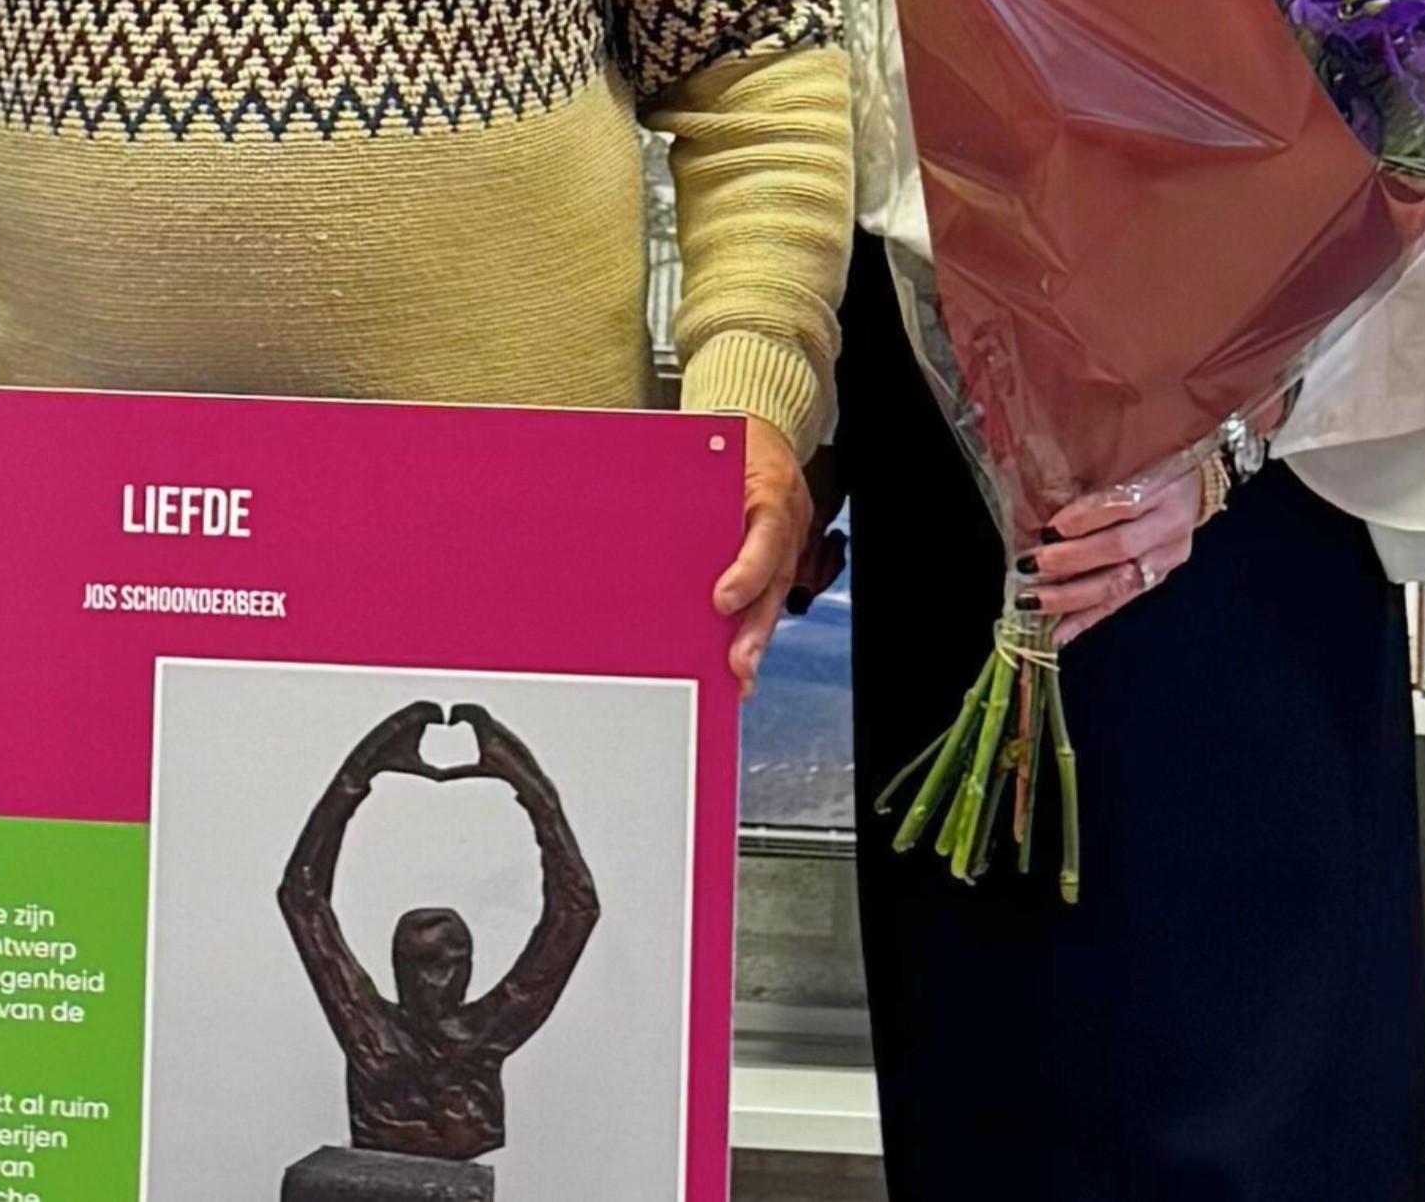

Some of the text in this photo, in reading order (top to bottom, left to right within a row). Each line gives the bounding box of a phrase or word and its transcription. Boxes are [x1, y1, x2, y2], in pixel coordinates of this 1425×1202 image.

[122, 483, 253, 538] LIEFDE
[82, 583, 287, 617] JOS SCHOONDERBEEK
[14, 904, 55, 932] zijn
[51, 999, 86, 1023] de
[19, 1095, 44, 1117] al
[50, 1097, 109, 1120] ruim
